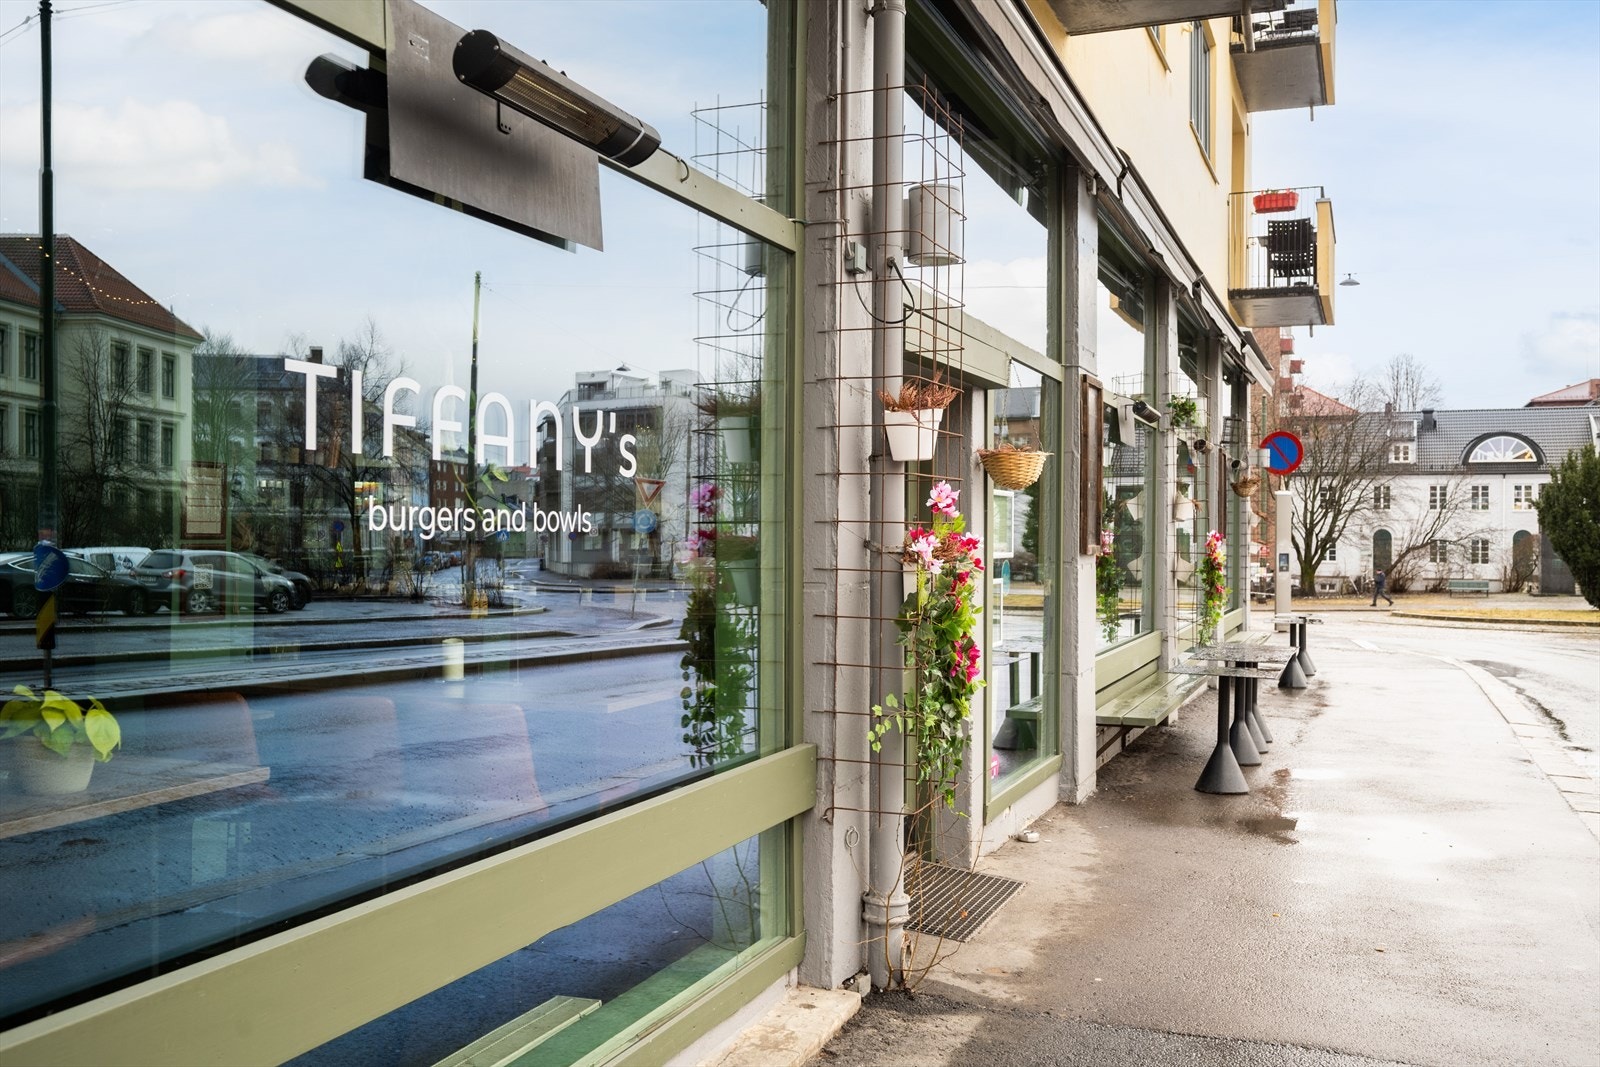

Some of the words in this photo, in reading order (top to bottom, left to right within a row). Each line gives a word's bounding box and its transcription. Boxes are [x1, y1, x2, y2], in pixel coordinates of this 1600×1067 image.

[368, 495, 476, 540] burgers
[482, 502, 527, 532] and
[533, 503, 592, 534] bowls
